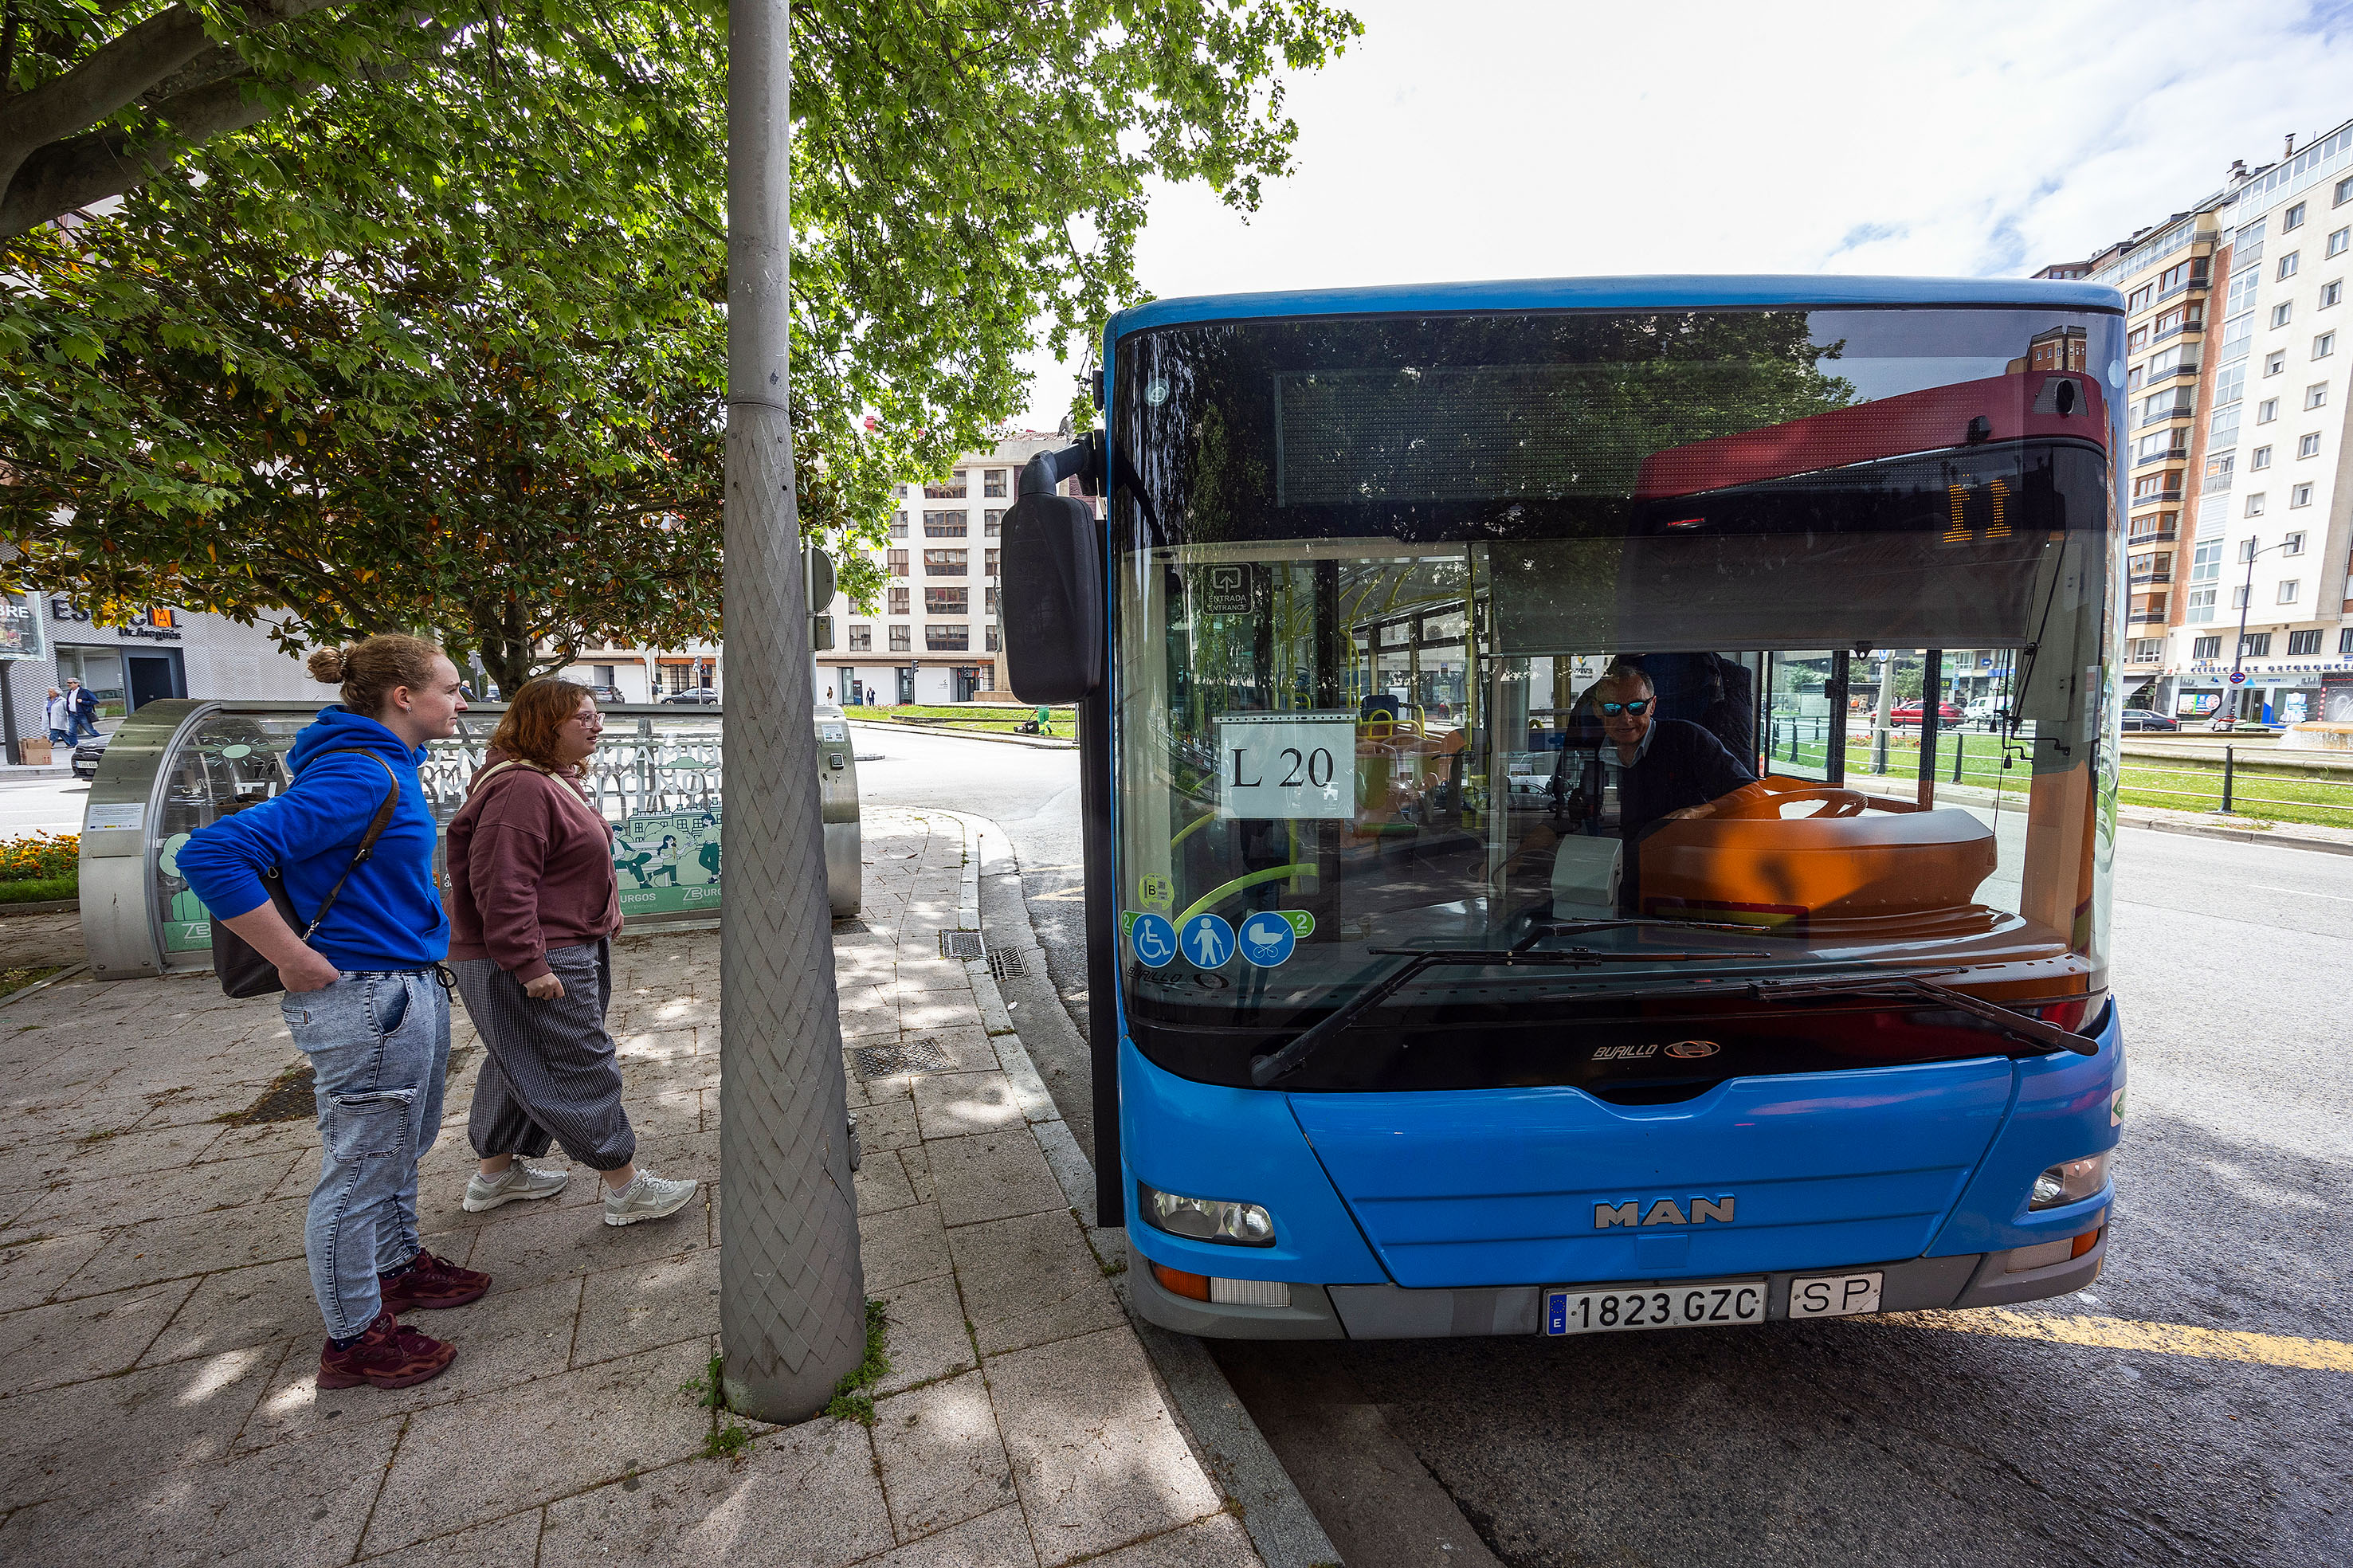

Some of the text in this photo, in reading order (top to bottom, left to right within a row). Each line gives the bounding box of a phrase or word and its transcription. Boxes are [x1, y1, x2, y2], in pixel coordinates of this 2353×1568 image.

[53, 599, 182, 628] ESCIAL
[1230, 747, 1334, 788] L 20
[655, 771, 722, 795] NOT
[620, 892, 657, 904] URGOS
[1148, 884, 1156, 896] B
[1124, 914, 1131, 929] 2
[1296, 914, 1308, 930] 2
[1127, 966, 1182, 985] BURILLO
[1592, 1044, 1658, 1060] BURILLO
[1594, 1195, 1735, 1229] MAN
[1553, 1288, 1757, 1328] E 1823 GZC
